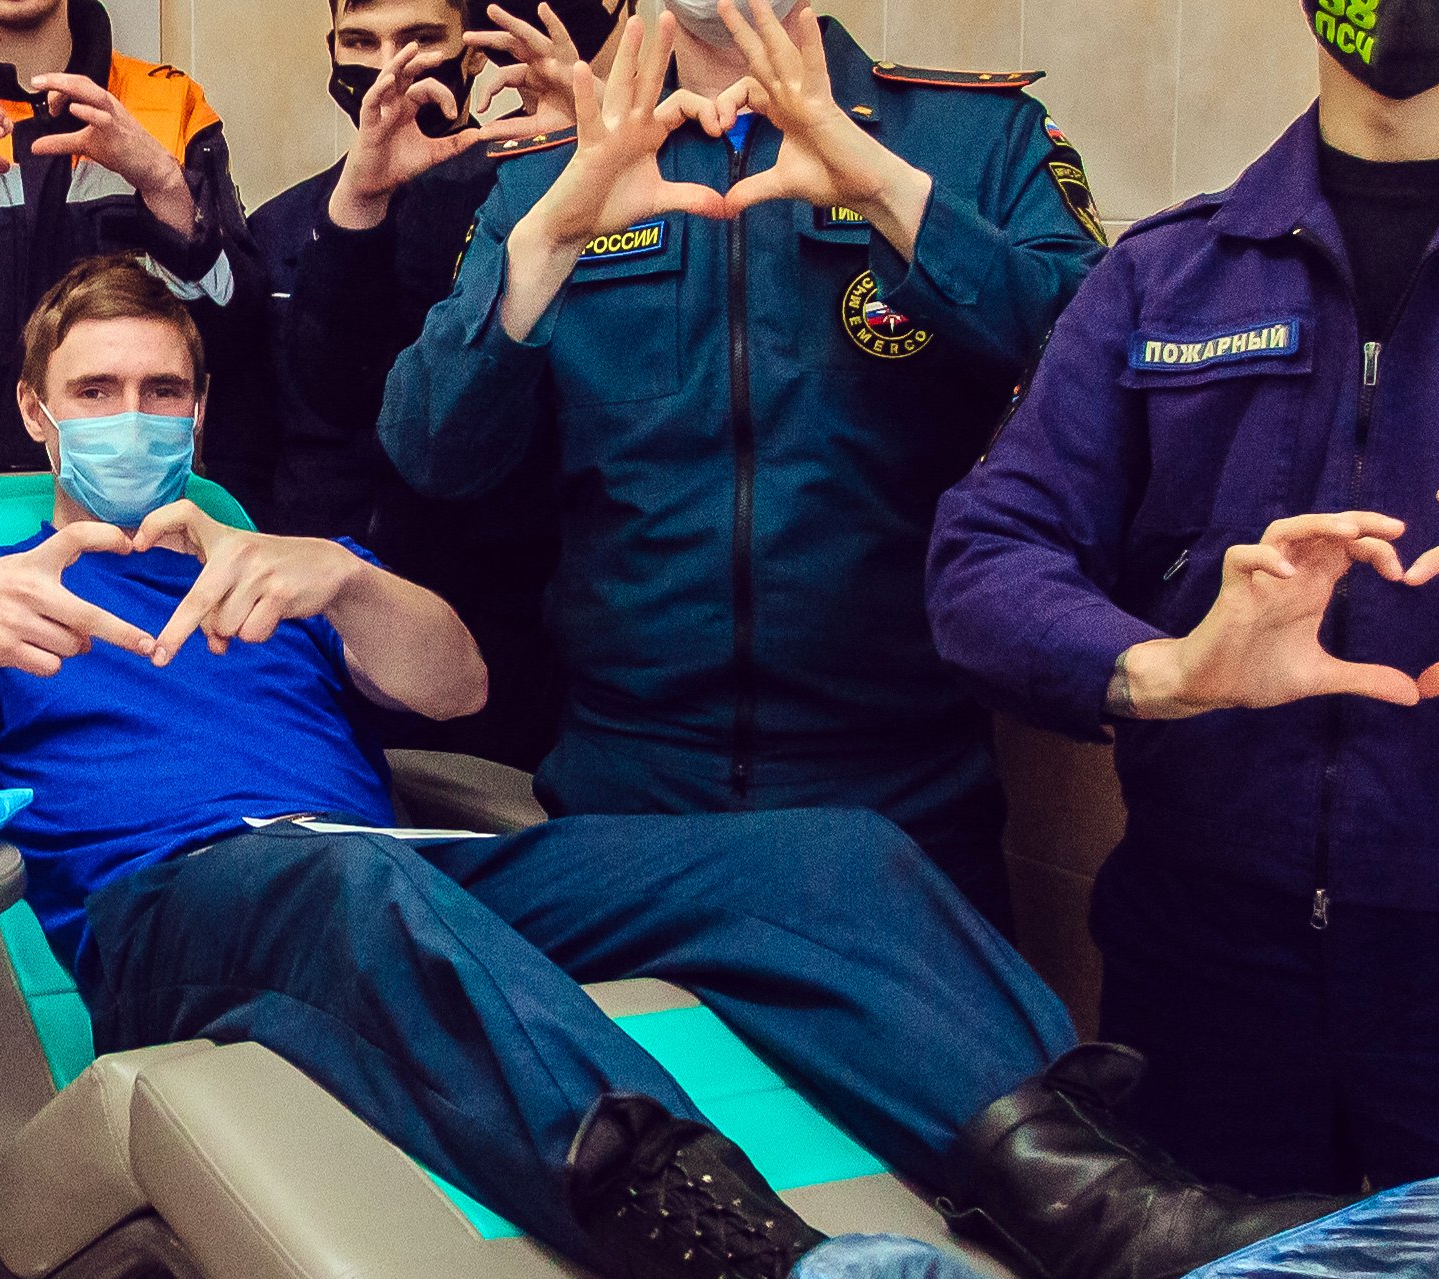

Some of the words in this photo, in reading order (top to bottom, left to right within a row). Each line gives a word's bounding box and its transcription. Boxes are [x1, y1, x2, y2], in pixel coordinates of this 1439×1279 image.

[1315, 10, 1375, 64] ПСЧ
[849, 277, 874, 309] МЧС
[849, 316, 927, 355] EMERCO
[1144, 324, 1290, 364] ПОЖАРНЫЙ
